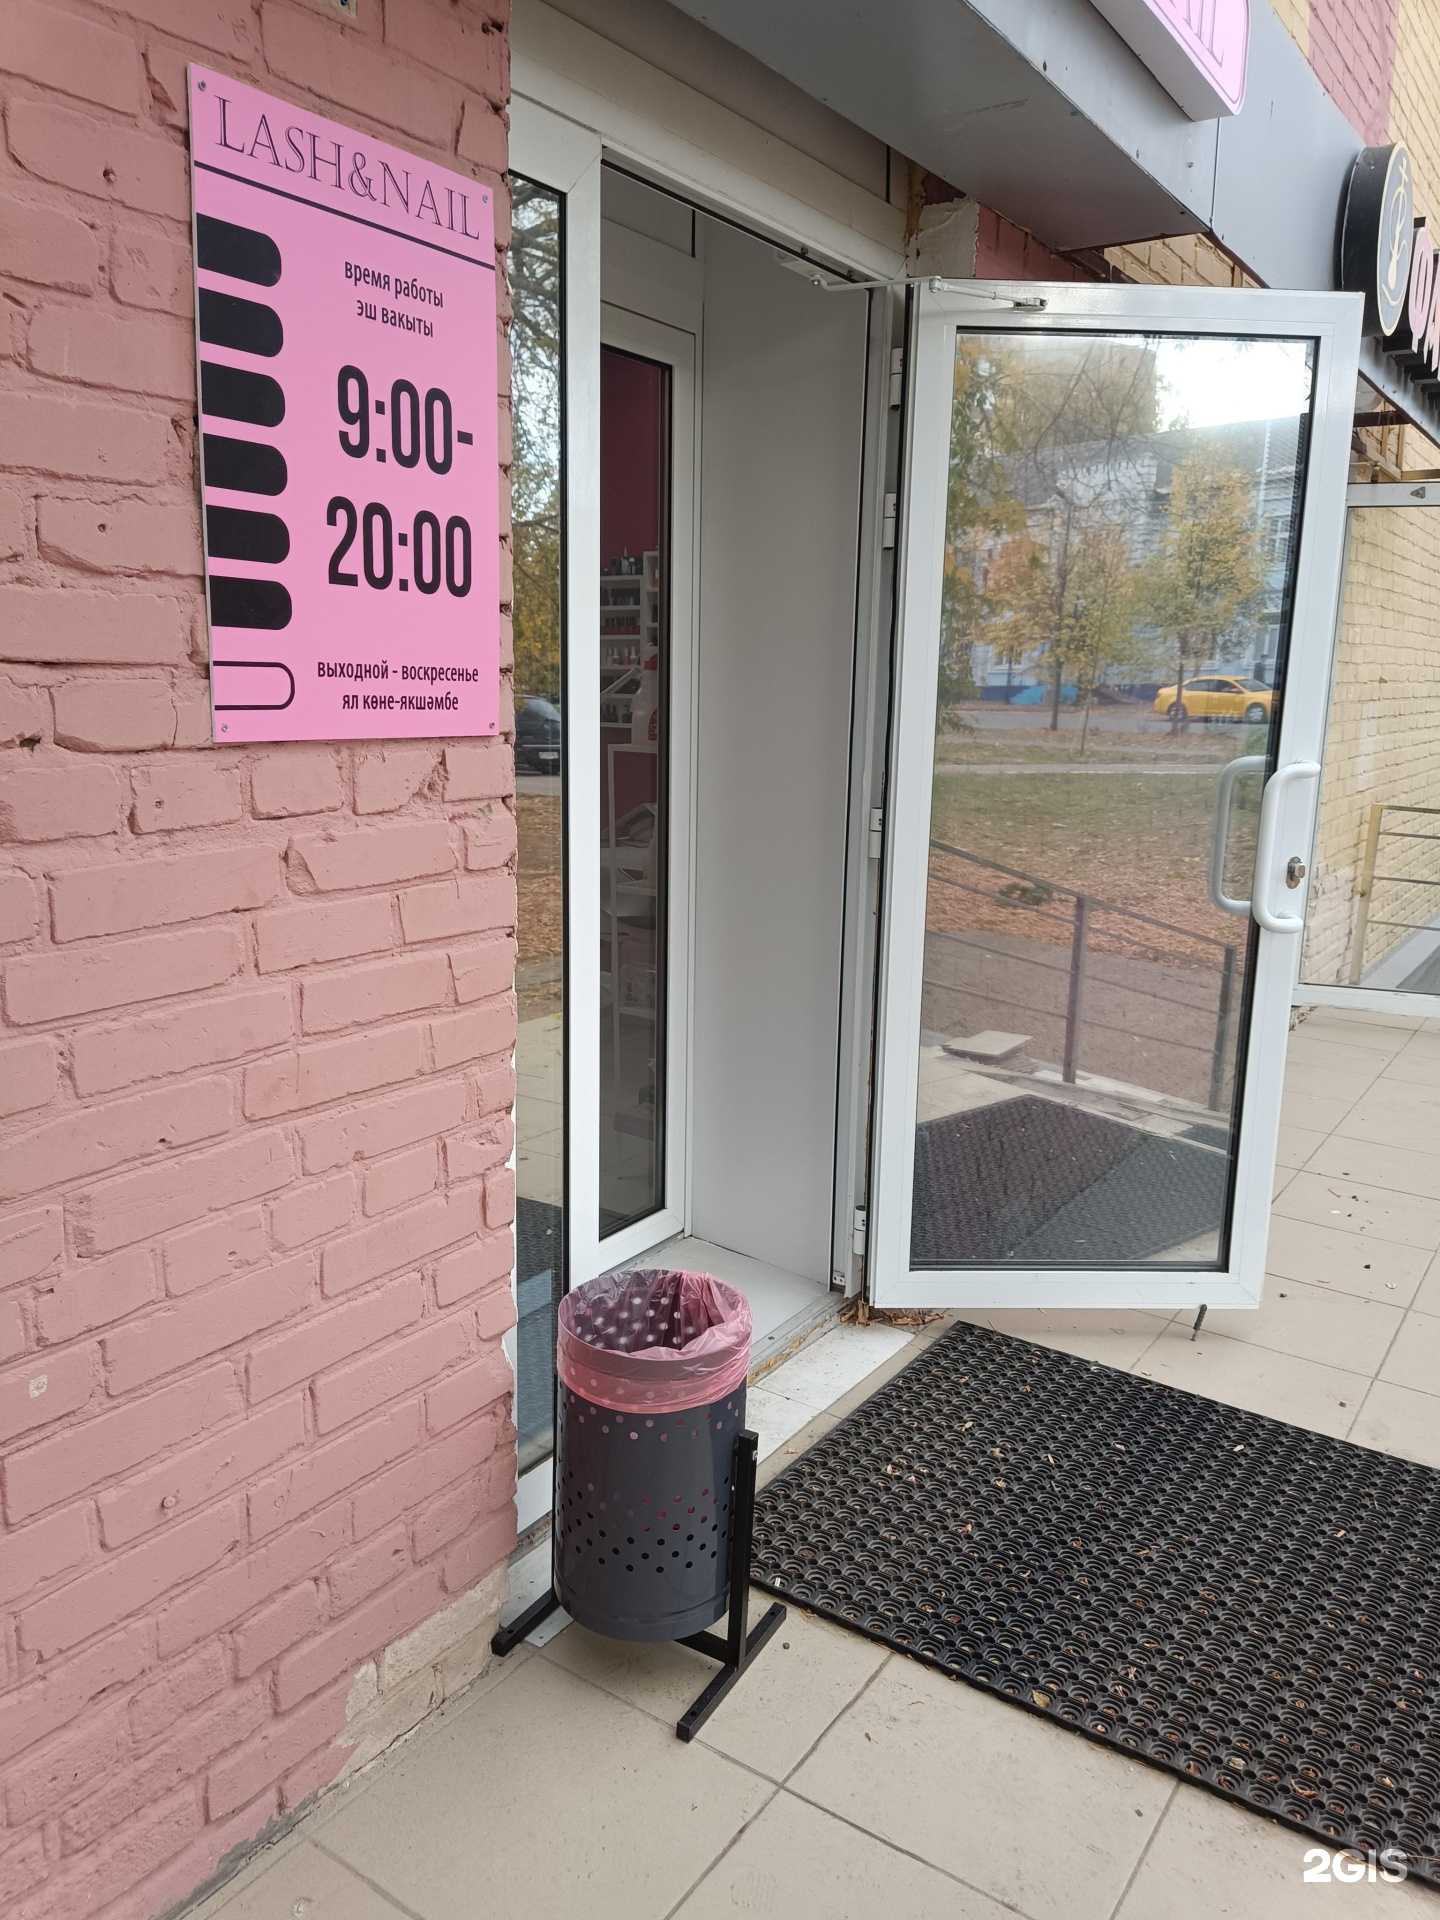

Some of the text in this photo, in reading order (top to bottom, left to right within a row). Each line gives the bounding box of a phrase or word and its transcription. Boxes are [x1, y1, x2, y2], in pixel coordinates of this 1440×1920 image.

[214, 95, 480, 241] LASH&NAIL
[344, 260, 444, 308] время работы
[356, 299, 434, 338] эш вакыты
[337, 364, 474, 476] 9:00-
[326, 495, 472, 598] 20:00
[317, 659, 389, 682] выходной
[401, 665, 479, 686] воскресенье
[342, 691, 459, 711] ял көне-якшәмбе
